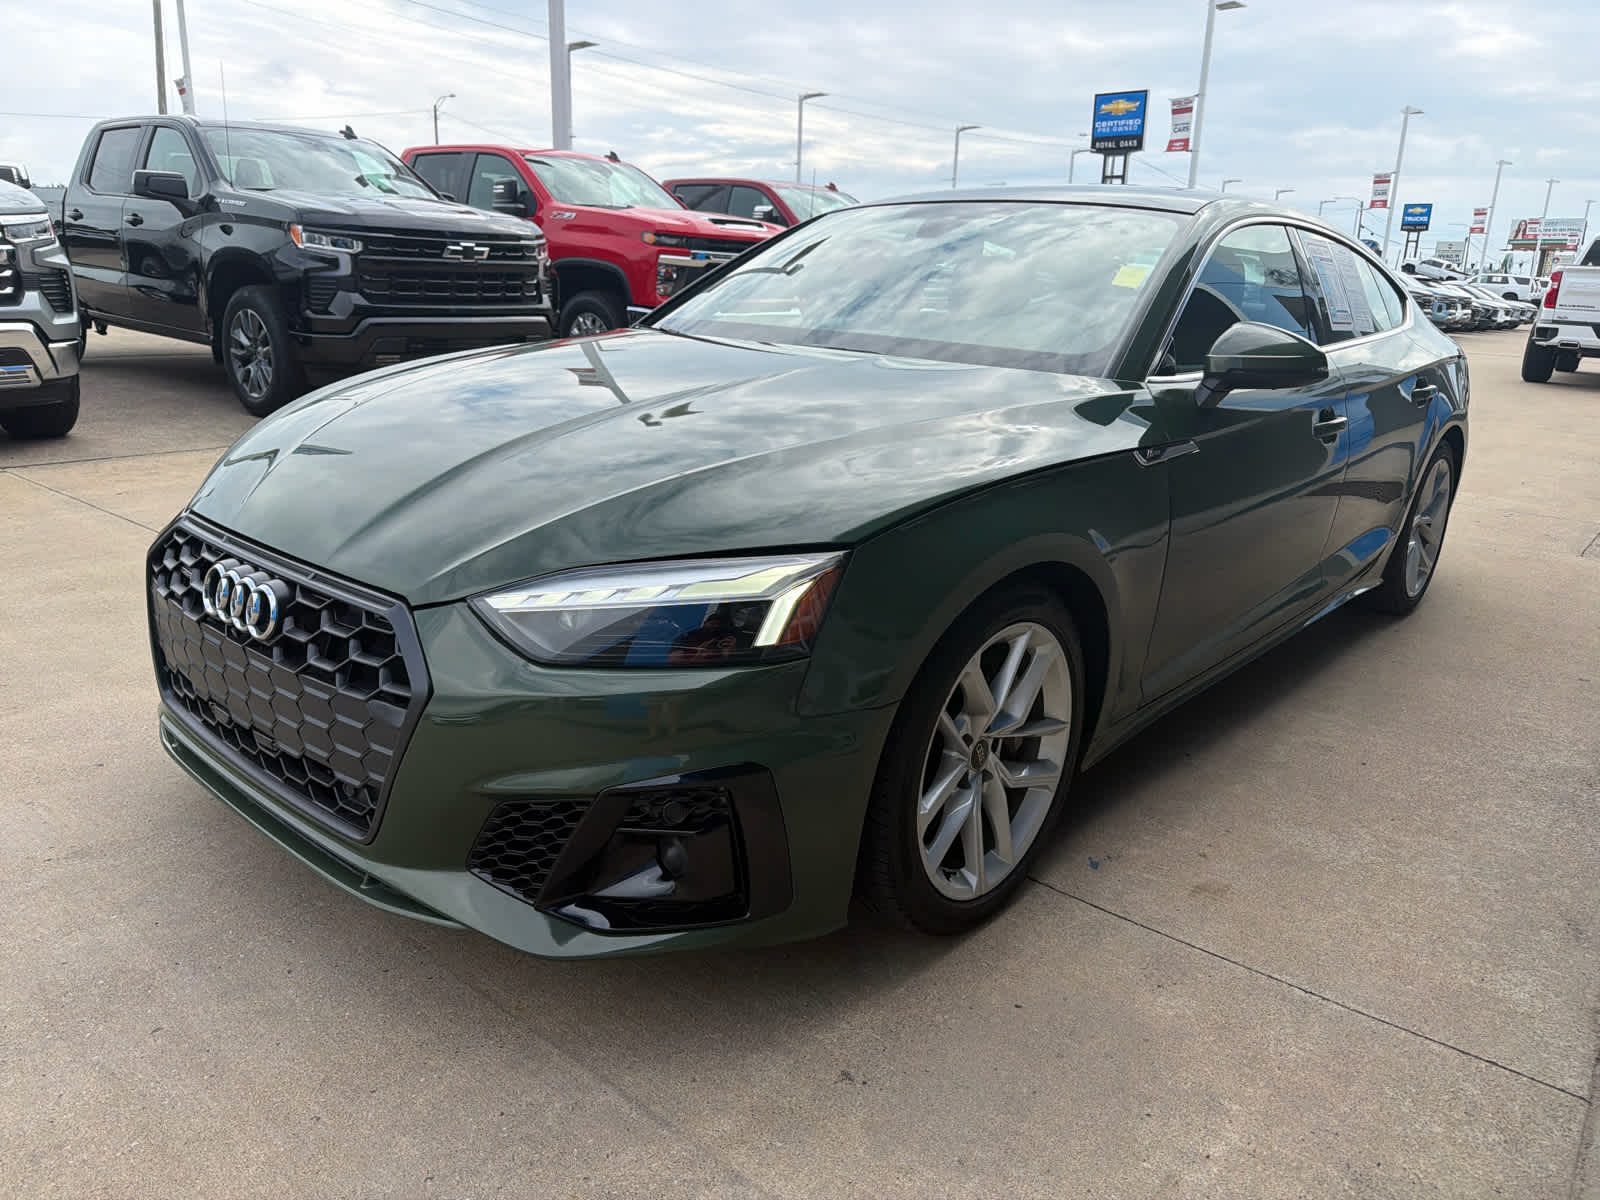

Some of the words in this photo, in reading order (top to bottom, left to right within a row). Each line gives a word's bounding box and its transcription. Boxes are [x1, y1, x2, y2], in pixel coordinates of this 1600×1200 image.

[1095, 119, 1141, 128] CERTIFIED
[1095, 141, 1117, 149] ROYAL
[1119, 140, 1138, 148] OAKS
